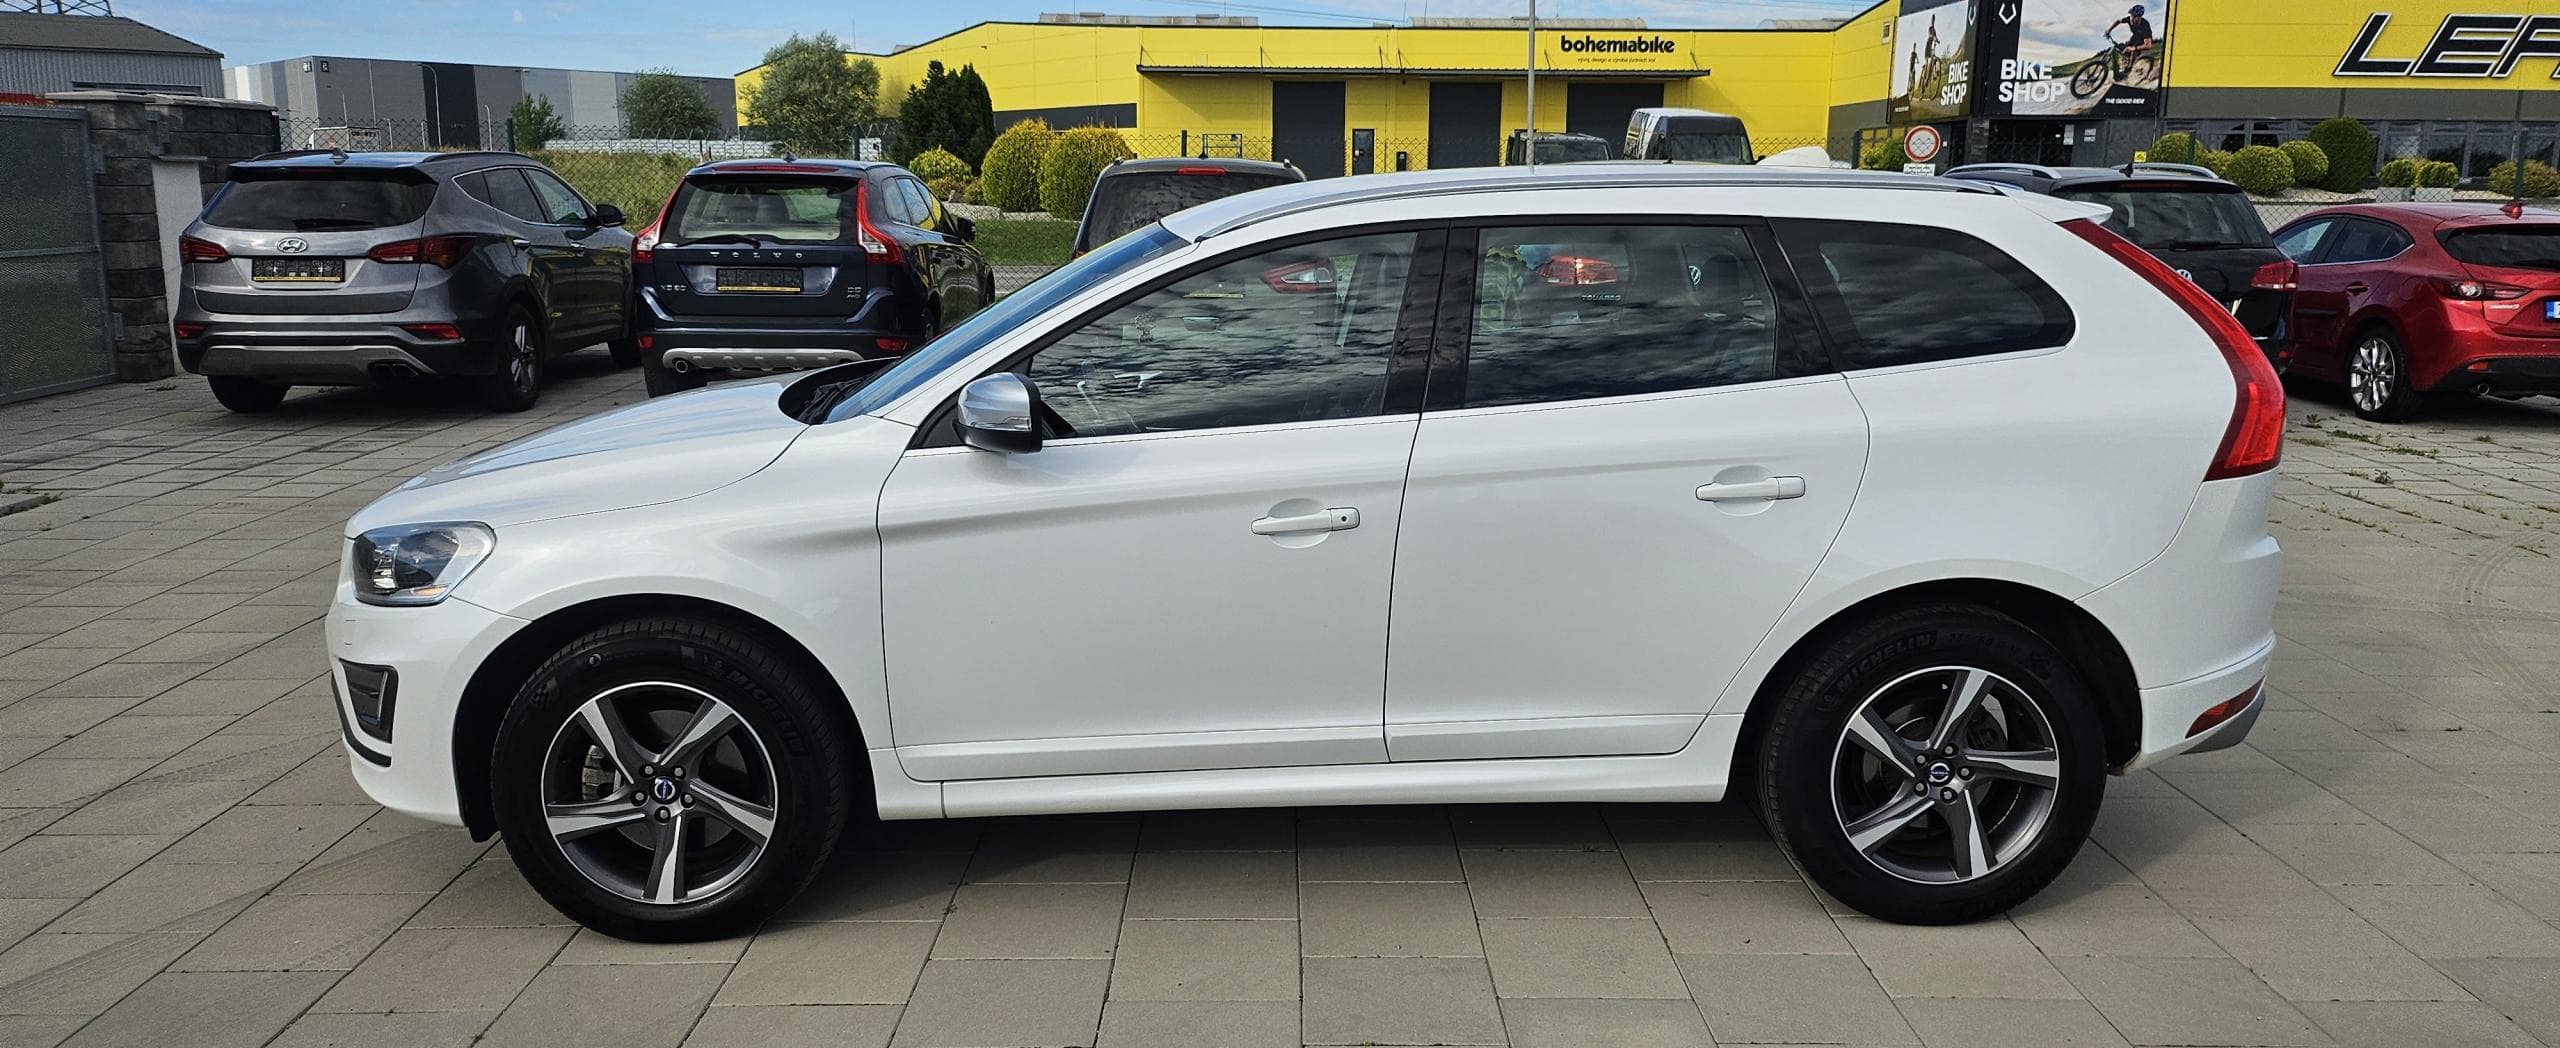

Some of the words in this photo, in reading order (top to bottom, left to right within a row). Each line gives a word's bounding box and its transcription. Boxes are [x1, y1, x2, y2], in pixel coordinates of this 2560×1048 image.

[1561, 35, 1675, 53] bohemiabike
[1948, 61, 1969, 83] BIKE
[2000, 58, 2053, 80] BIKE
[1941, 83, 1967, 106] SHOP
[1998, 81, 2066, 103] SHOP
[710, 251, 803, 259] VOLVO
